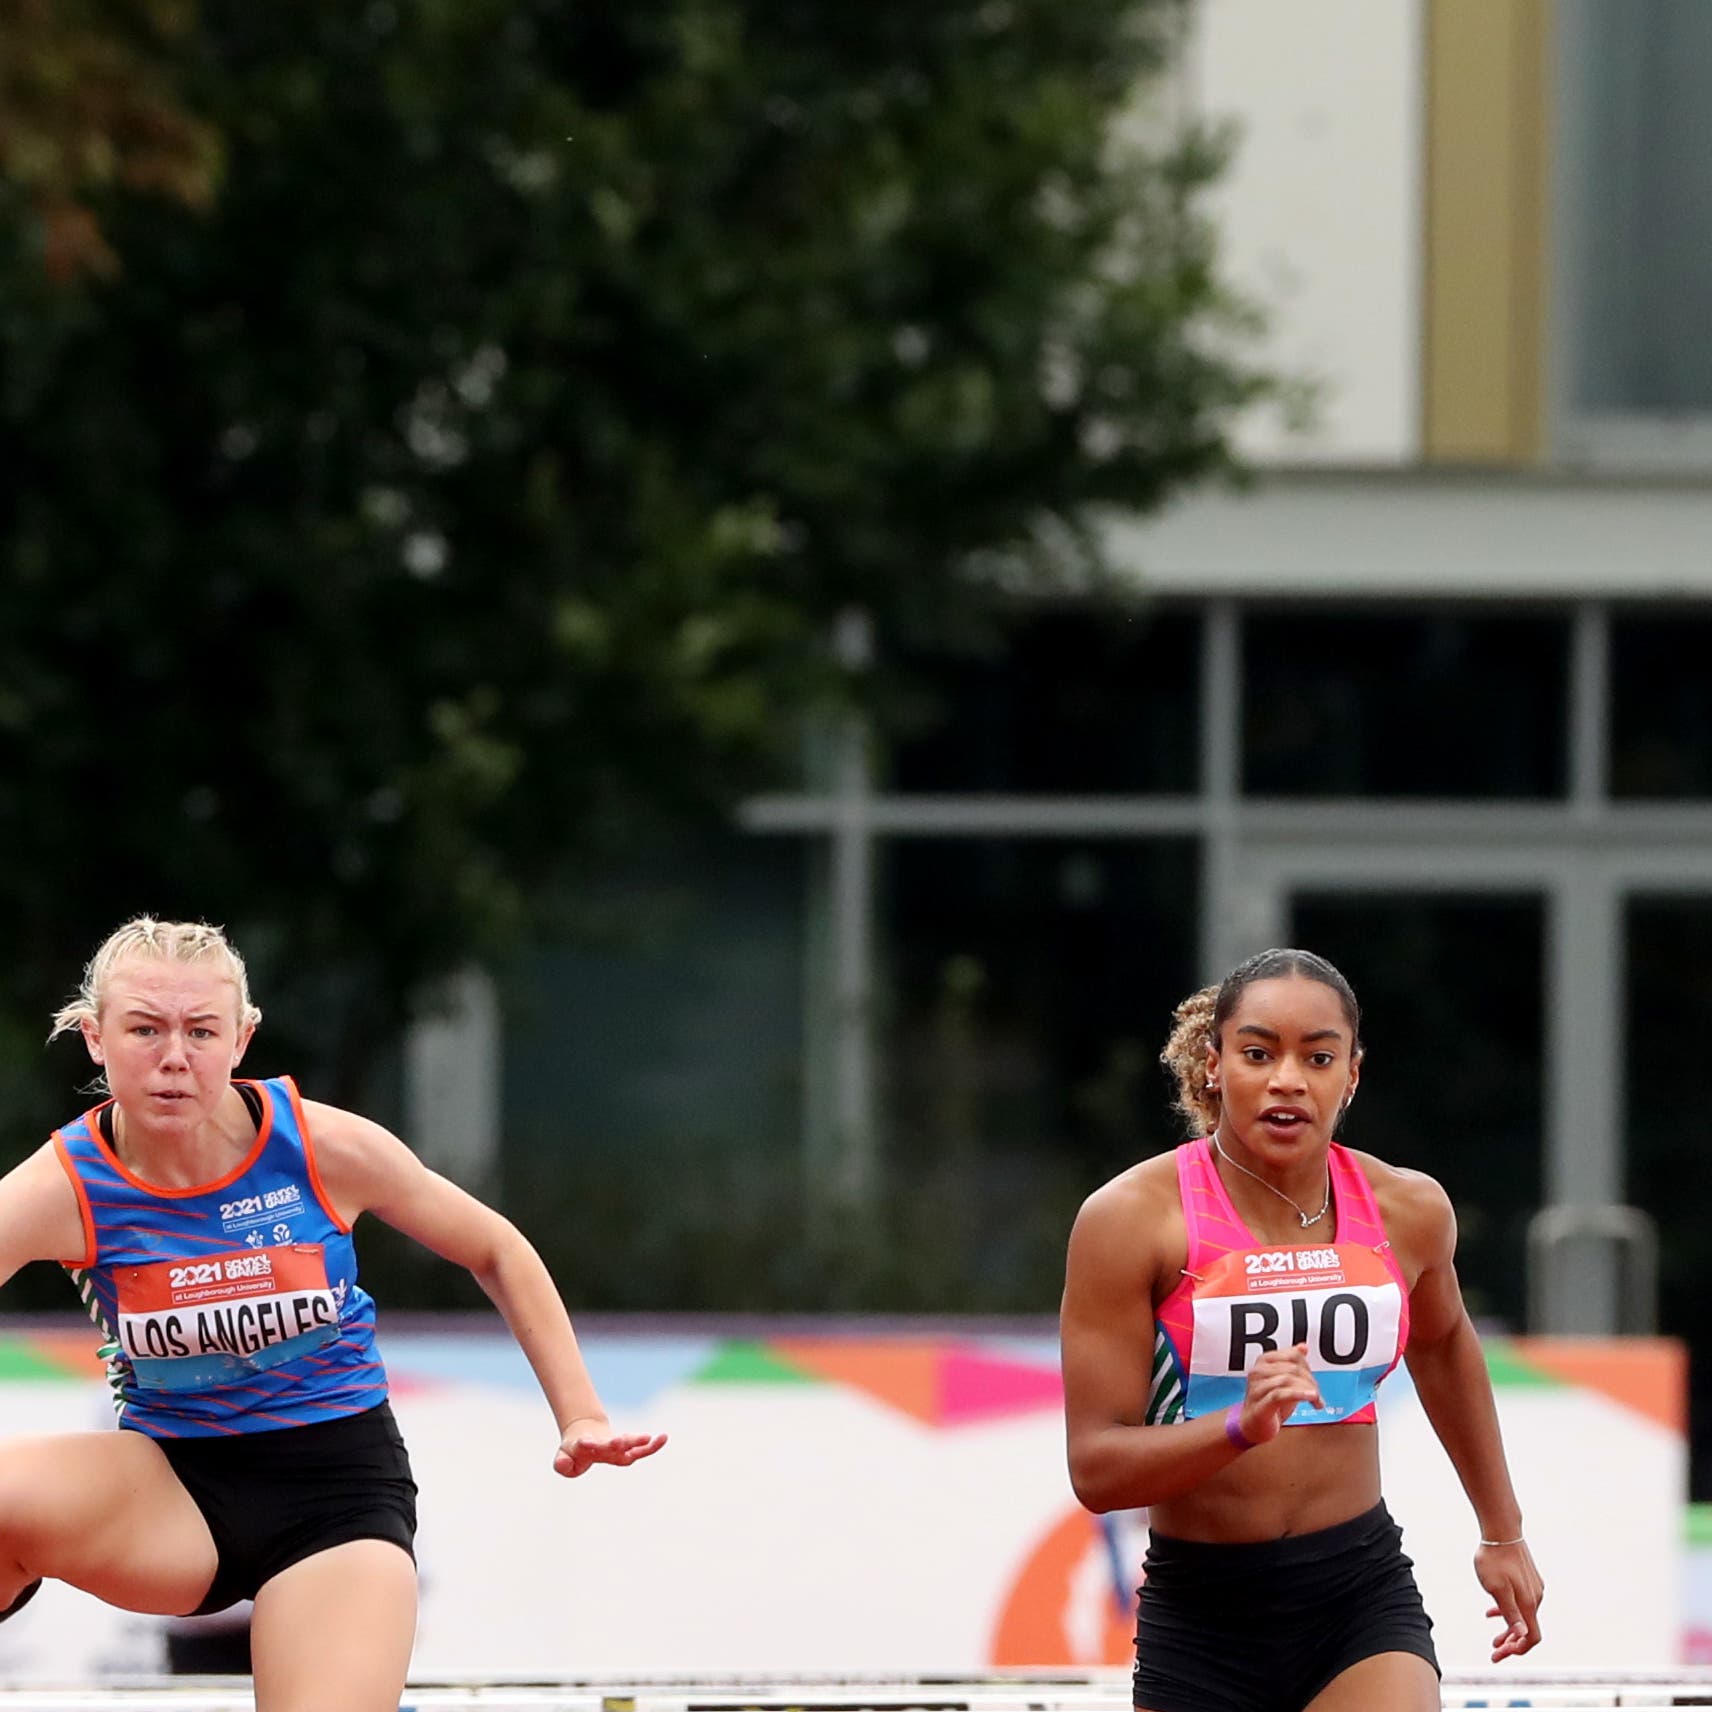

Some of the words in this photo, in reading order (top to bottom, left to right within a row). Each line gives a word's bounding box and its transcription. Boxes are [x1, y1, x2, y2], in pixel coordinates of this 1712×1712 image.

[219, 1195, 263, 1220] 2021
[169, 1262, 222, 1288] 2021
[1244, 1251, 1294, 1274] 2021
[236, 1281, 273, 1292] University
[127, 1315, 190, 1358] LOS
[197, 1295, 332, 1356] ANGELES
[1228, 1293, 1369, 1372] RIO
